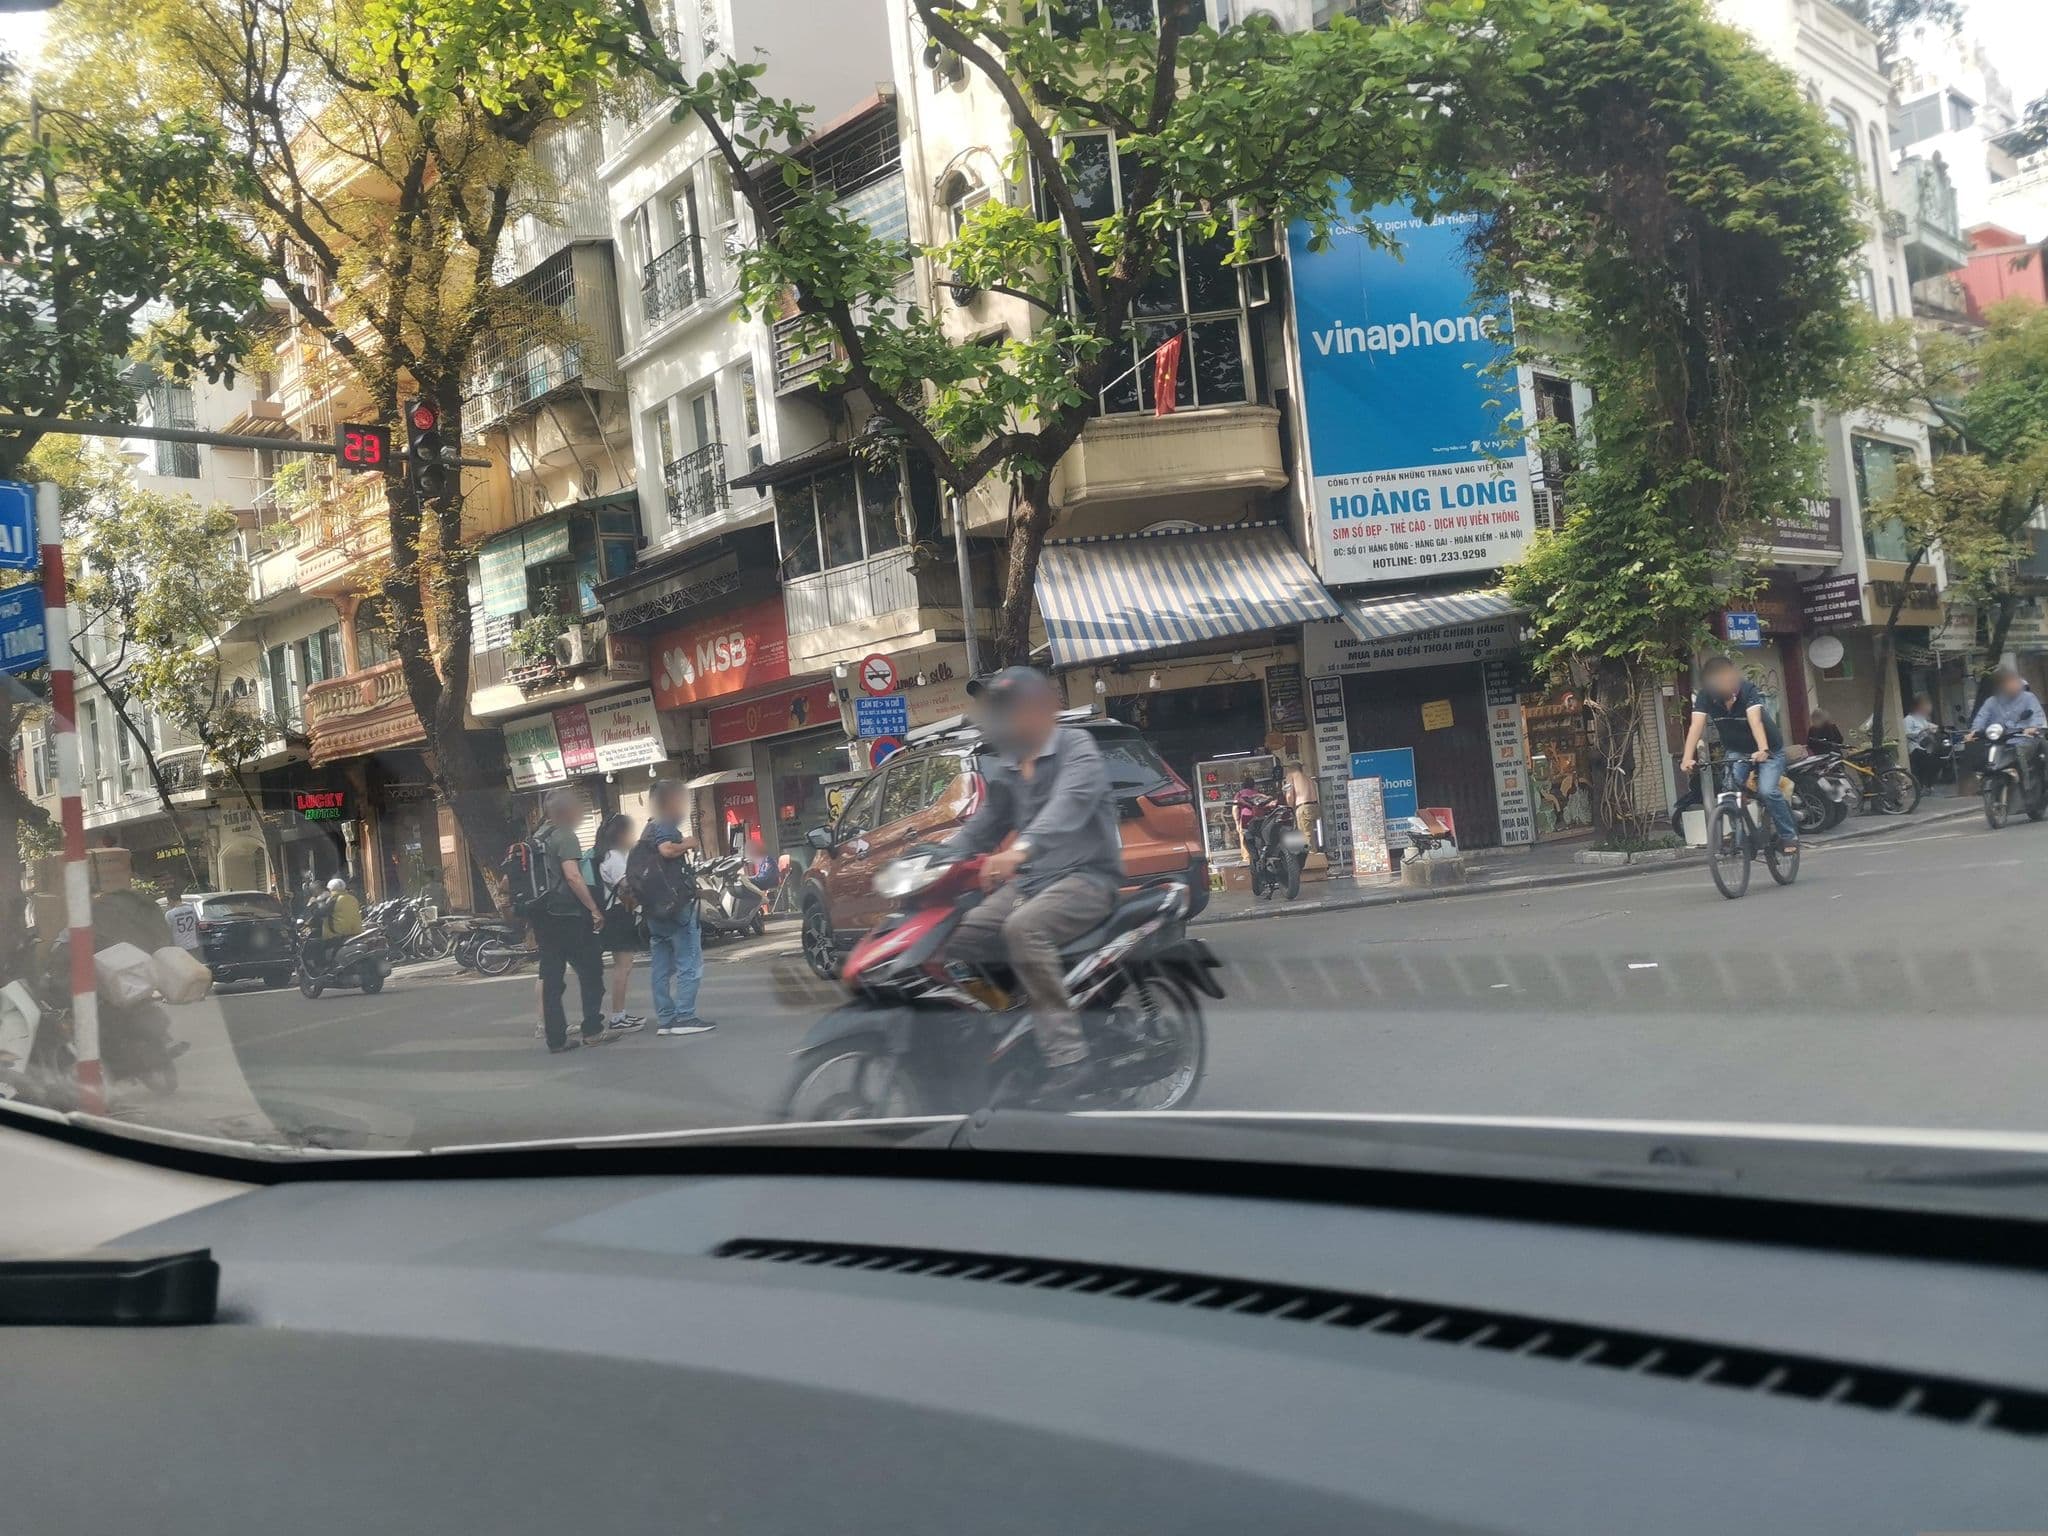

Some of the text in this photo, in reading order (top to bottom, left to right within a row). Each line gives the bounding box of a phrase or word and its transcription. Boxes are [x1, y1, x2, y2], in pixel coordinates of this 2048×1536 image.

[1385, 220, 1407, 232] DỊCH
[1311, 311, 1498, 356] vinaphone
[344, 433, 381, 463] 23
[1351, 477, 1360, 485] TY
[1329, 479, 1518, 520] HOÀNG LONG
[1333, 527, 1350, 540] SIM
[1352, 522, 1364, 538] SỐ
[1365, 524, 1382, 539] ĐẸP
[1434, 516, 1454, 532] DỊCH
[1456, 515, 1468, 529] VỤ
[1358, 545, 1366, 554] 01
[1372, 548, 1487, 569] HOTLINE: 091.233.9298
[695, 631, 747, 678] MSB
[1348, 649, 1371, 661] MUA
[1397, 643, 1421, 658] ĐIỆN
[1423, 640, 1453, 655] THOẠI
[613, 711, 633, 726] Shop
[297, 792, 345, 809] LUCKY
[304, 808, 341, 820] HOTEL
[177, 915, 194, 934] 52
